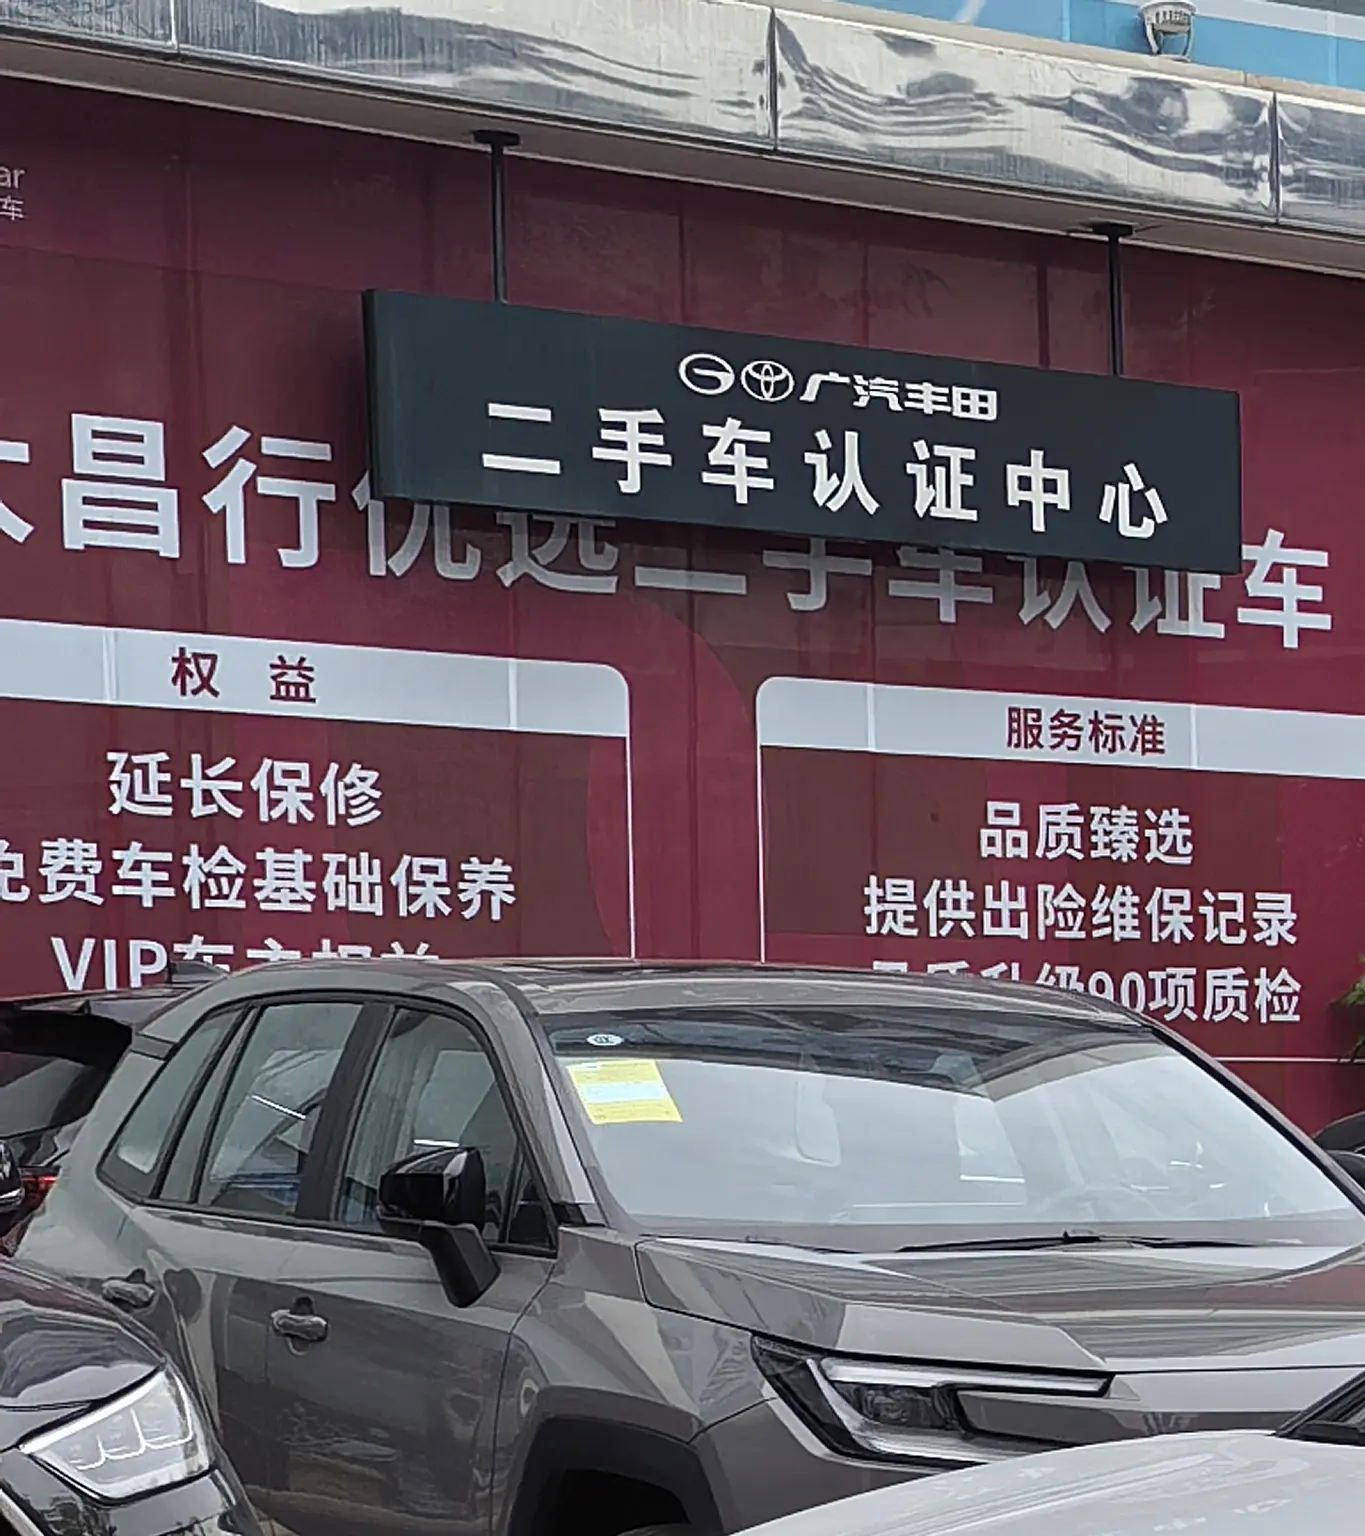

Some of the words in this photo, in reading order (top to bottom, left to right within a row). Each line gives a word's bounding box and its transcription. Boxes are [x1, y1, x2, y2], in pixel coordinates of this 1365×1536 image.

[800, 370, 998, 421] 广汽丰田
[481, 402, 1168, 539] 二手车认证中心
[171, 646, 318, 704] 权益
[1006, 706, 1167, 756] 服务标准
[106, 750, 383, 827] 延长保修
[979, 800, 1195, 866] 品质臻选
[862, 874, 1298, 947] 提供出险维保记录
[872, 960, 1302, 1023] 级90项质检
